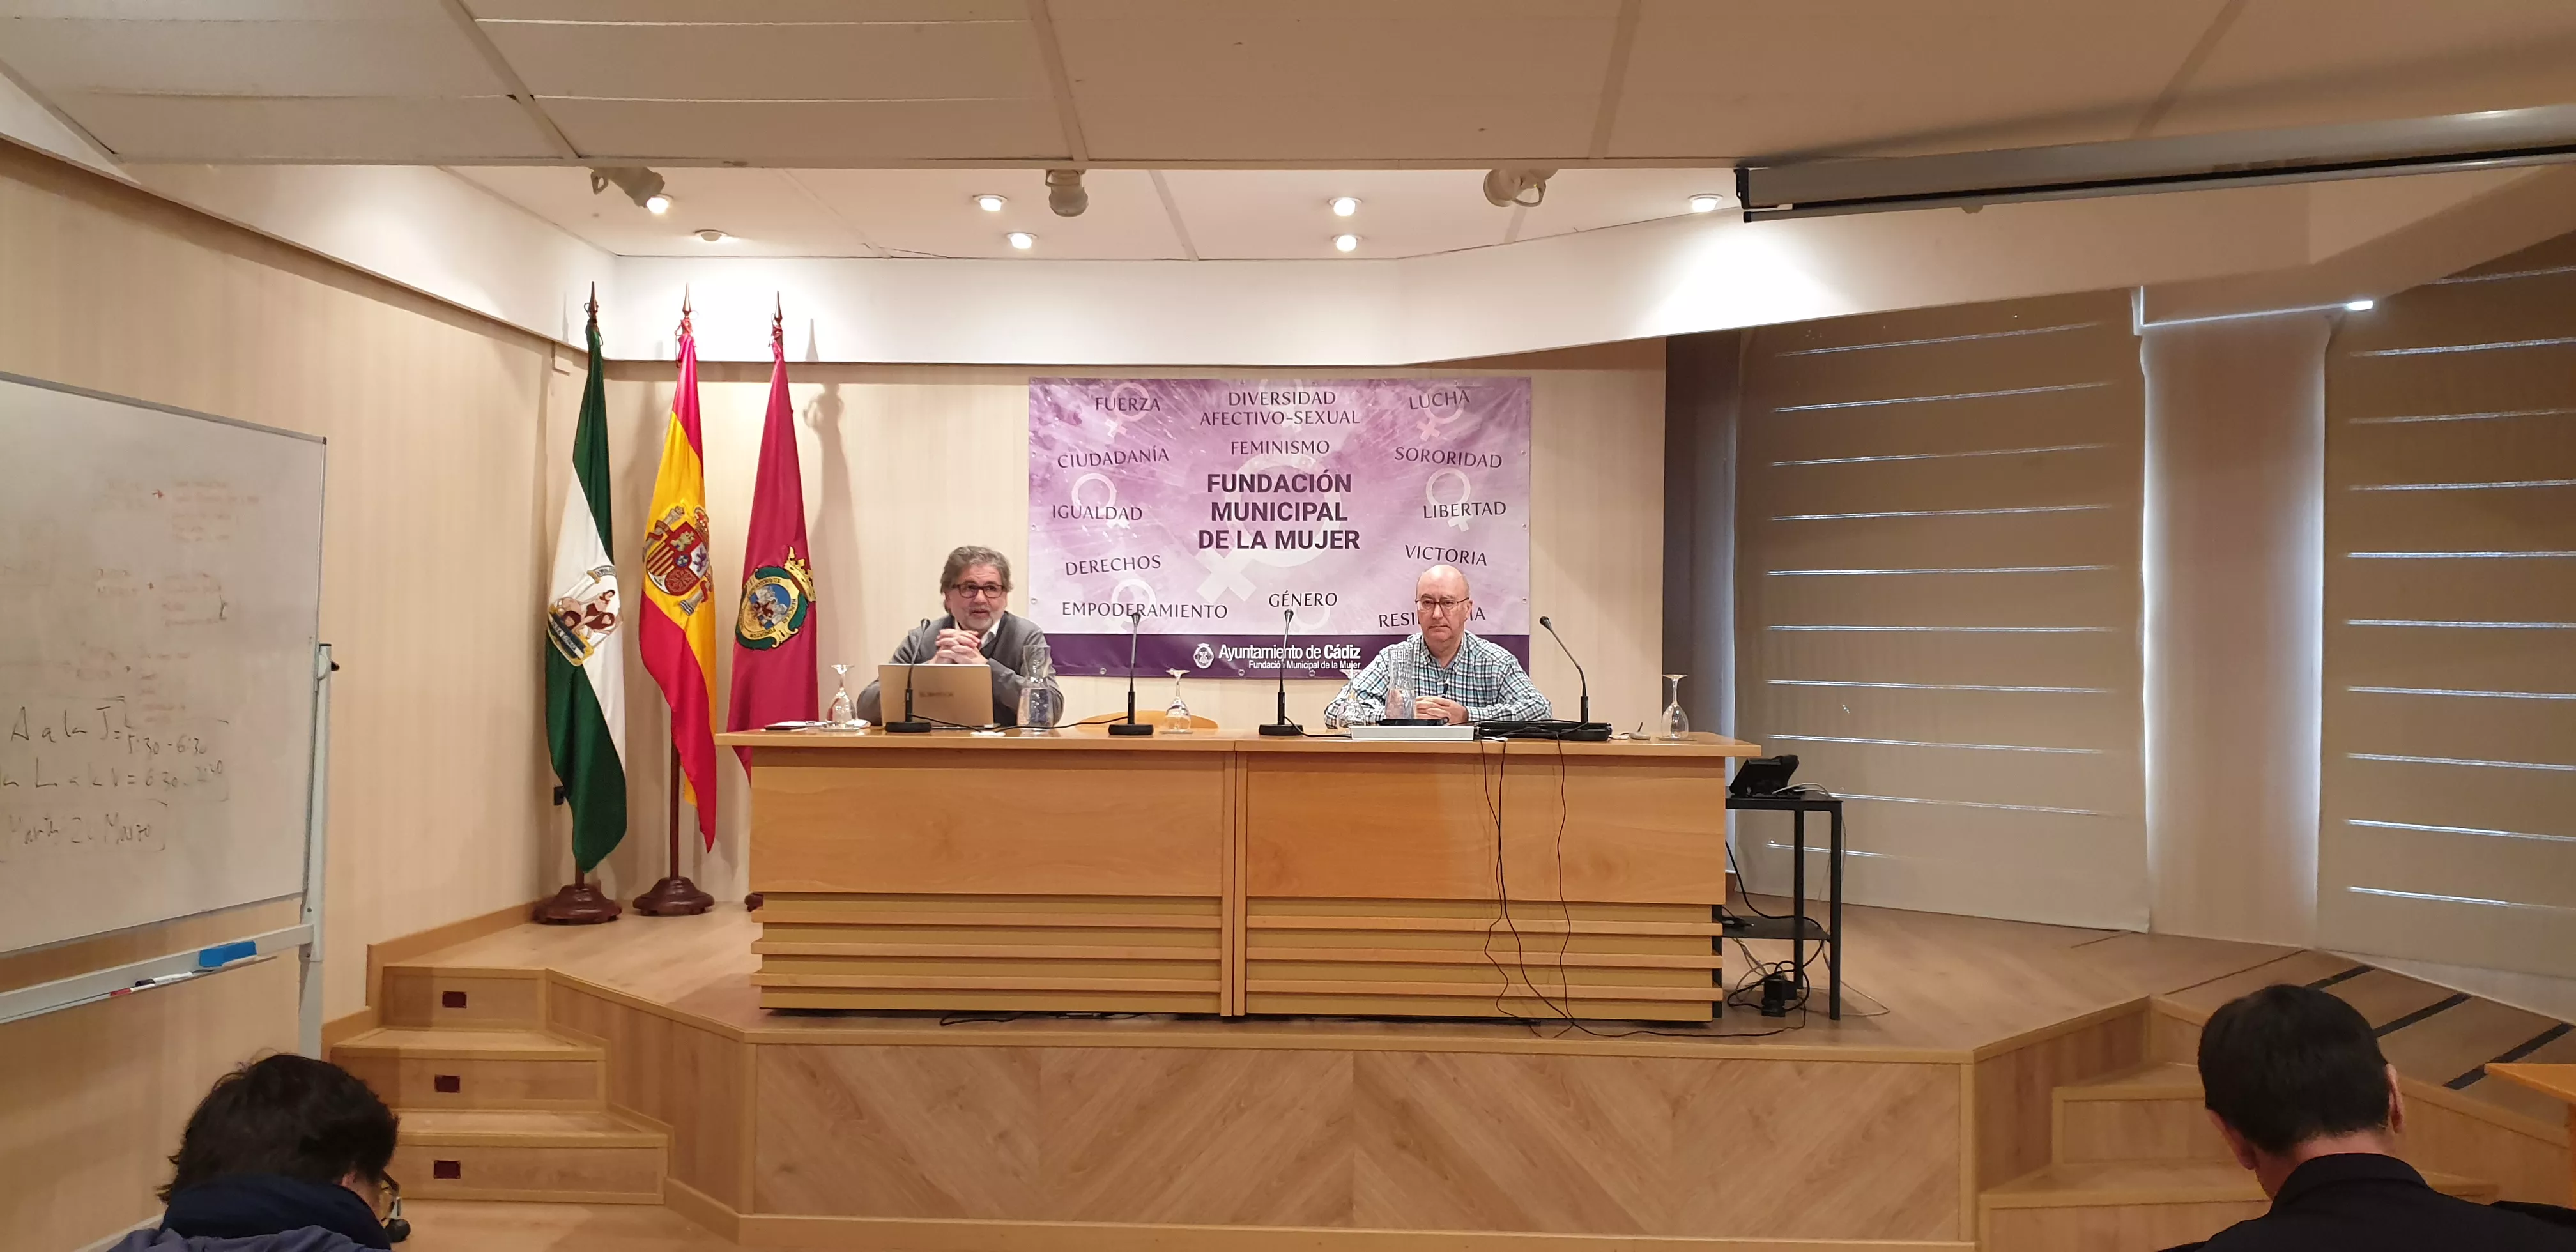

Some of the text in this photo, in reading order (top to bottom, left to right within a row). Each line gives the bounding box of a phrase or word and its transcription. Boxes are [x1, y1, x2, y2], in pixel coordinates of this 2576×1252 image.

[1095, 397, 1161, 411] FUERZA
[1229, 391, 1337, 406] DIVERSIDAD
[1409, 390, 1469, 410] LUCHA
[1200, 410, 1361, 426] AFECTIVO-SEXUAL
[1230, 440, 1330, 455] FEMINISMO
[1057, 445, 1170, 469] CIUDADANÍA
[1394, 447, 1503, 468] SORORIDAD
[1208, 469, 1352, 494] FUNDACIÓN
[1052, 504, 1143, 521] IGUALDAD
[1211, 501, 1348, 521] MUNICIPAL
[1423, 501, 1507, 519] LIBERTAD
[1199, 530, 1361, 550] DE LA MUJER
[1404, 544, 1488, 567] VICTORIA
[1065, 554, 1162, 576] DERECHOS
[1268, 590, 1338, 608] GÉNERO
[1062, 602, 1228, 618] EMPODERAMIENTO
[1379, 607, 1486, 627] RESIIA
[1218, 643, 1361, 661] Ayuntamiento de Cádiz
[1287, 660, 1320, 671] Municipal
[1321, 660, 1330, 669] de
[1331, 660, 1338, 669] la
[1340, 660, 1361, 671] Mujer
